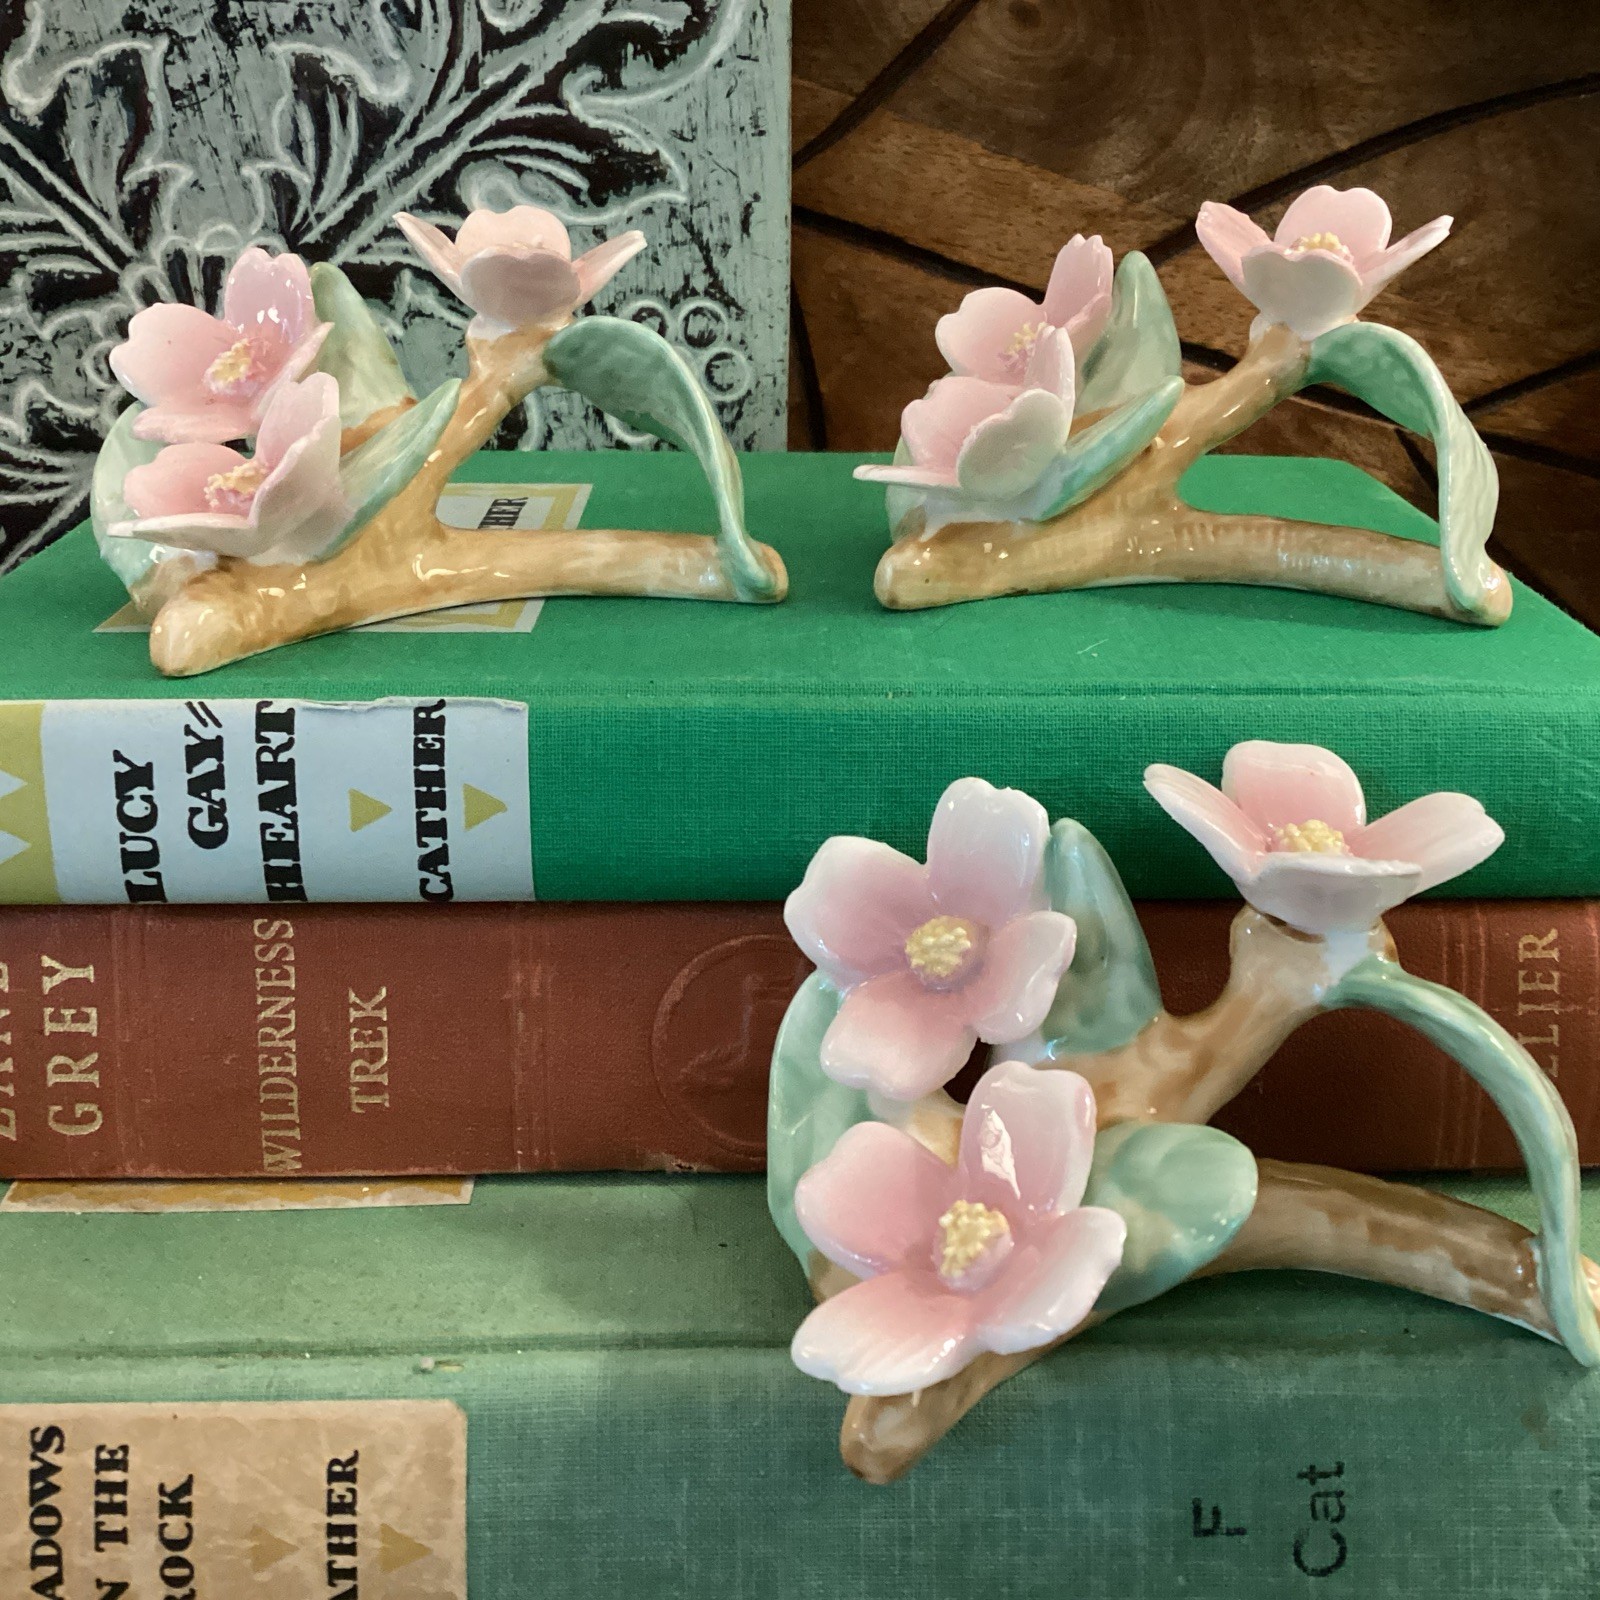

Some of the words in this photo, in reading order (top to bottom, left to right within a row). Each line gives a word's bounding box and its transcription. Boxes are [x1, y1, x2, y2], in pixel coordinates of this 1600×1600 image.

[478, 496, 529, 529] HER
[113, 749, 168, 902] LUCY
[255, 700, 308, 902] HEART
[412, 698, 454, 901] CATHER
[41, 955, 103, 1136] GREY
[253, 918, 302, 1172] WILDERNESS
[348, 986, 391, 1114] TREK
[94, 1443, 130, 1554] THE
[1191, 1497, 1248, 1538] F
[1293, 1461, 1348, 1578] Cat
